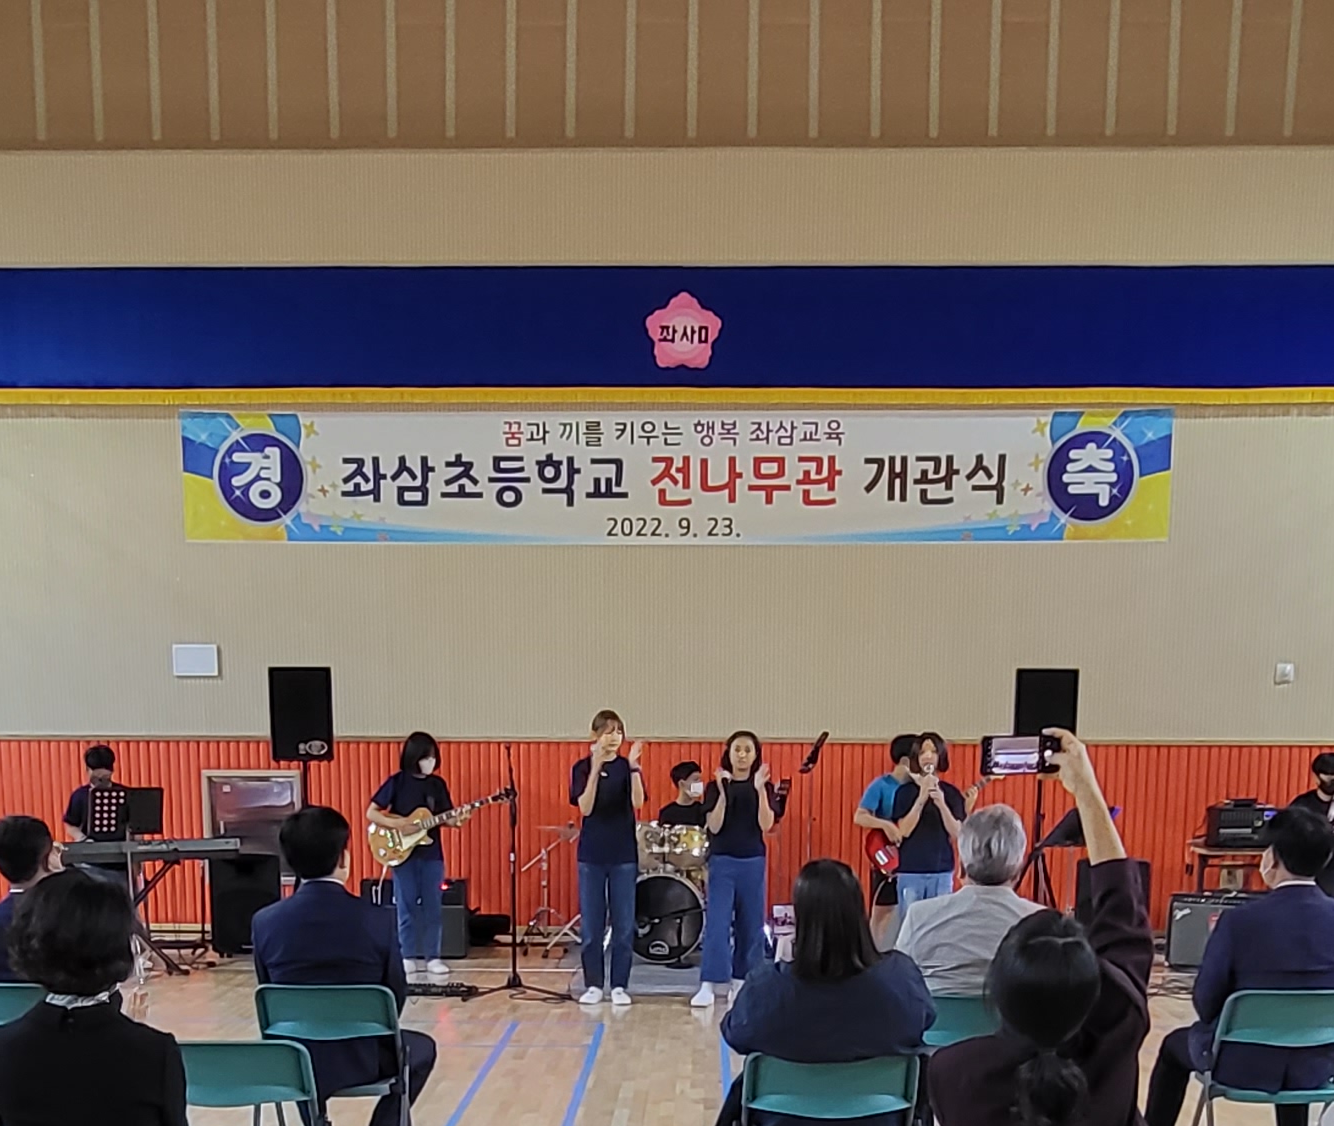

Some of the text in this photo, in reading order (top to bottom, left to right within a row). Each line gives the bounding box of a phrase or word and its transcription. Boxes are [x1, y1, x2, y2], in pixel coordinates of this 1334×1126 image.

[502, 419, 846, 448] 꿈과 끼를 키우는 행복 좌삼교육
[231, 446, 282, 509] 경
[340, 453, 1007, 508] 좌삼초등학교 전나무관 개관식
[1062, 442, 1118, 507] 축
[606, 517, 741, 538] 2022. 9. 23.
